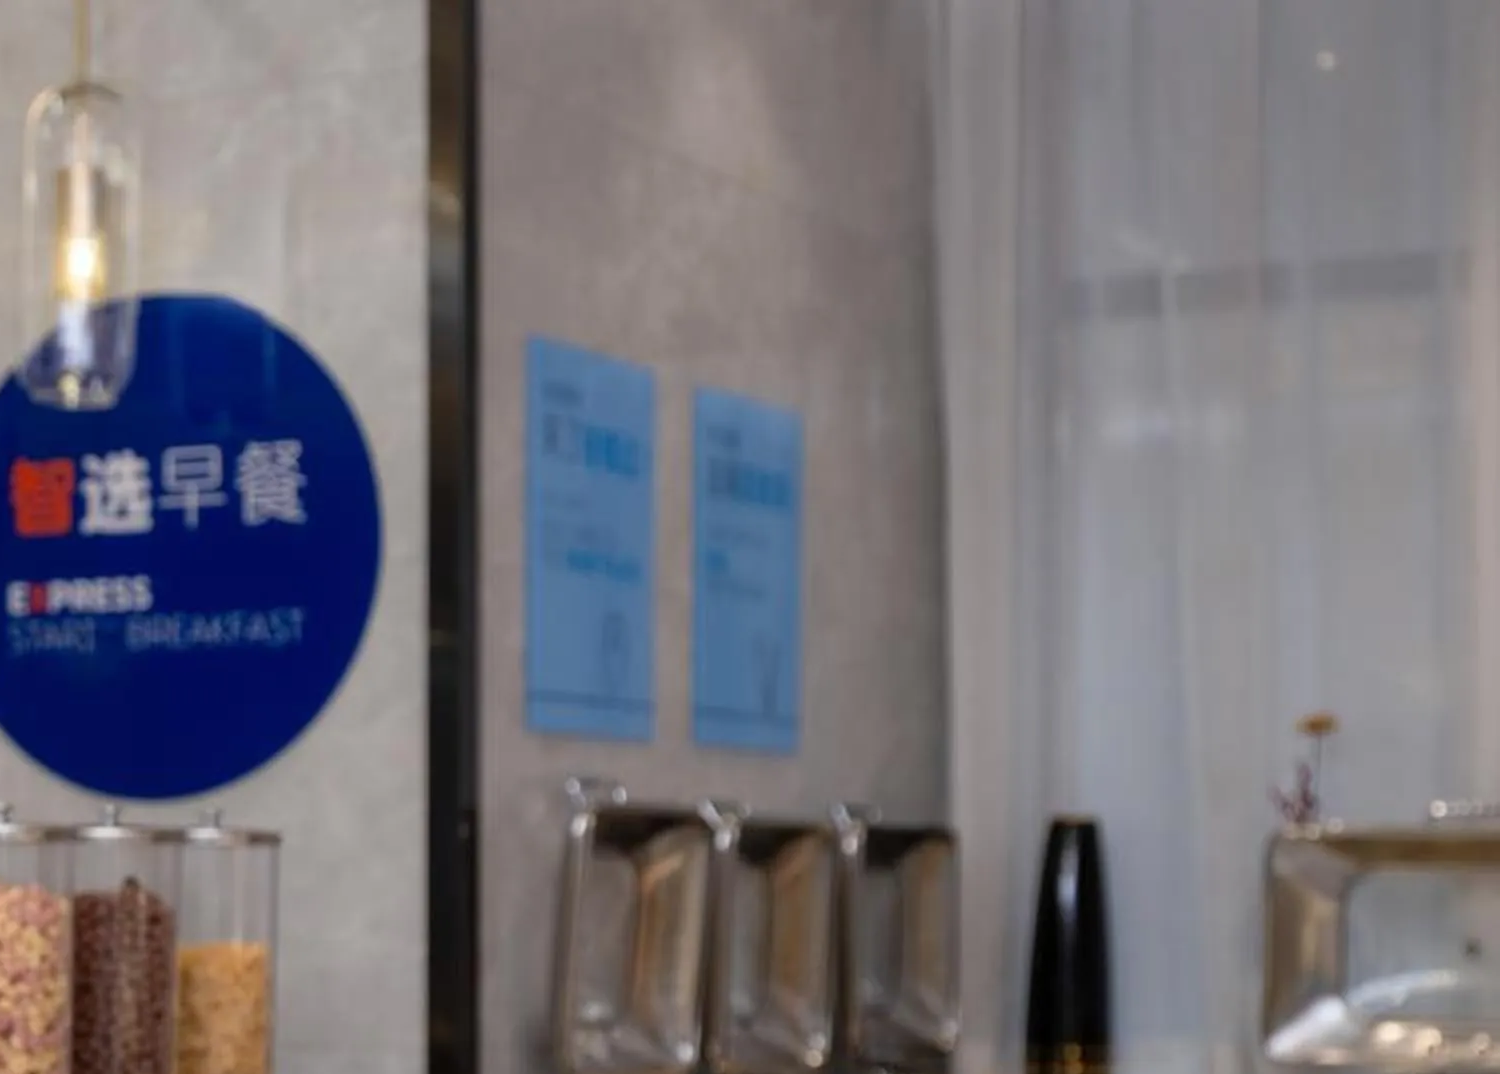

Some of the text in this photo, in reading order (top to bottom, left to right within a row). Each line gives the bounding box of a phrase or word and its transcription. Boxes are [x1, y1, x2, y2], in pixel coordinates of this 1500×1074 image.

[9, 438, 307, 537] 智选早餐
[125, 606, 303, 651] BREAKFAST
